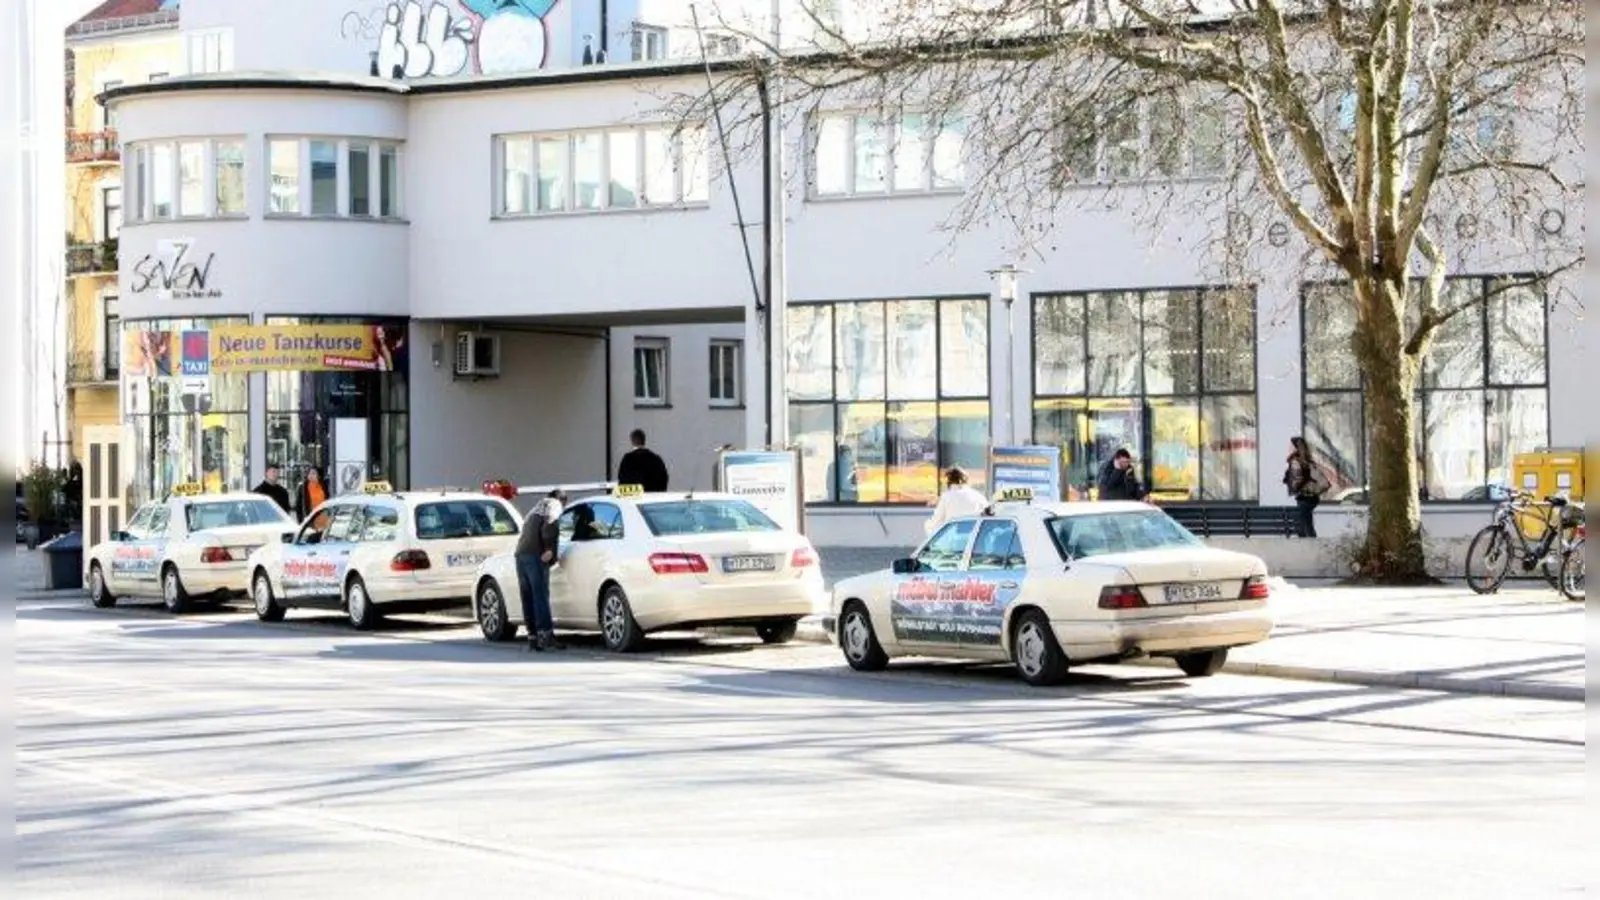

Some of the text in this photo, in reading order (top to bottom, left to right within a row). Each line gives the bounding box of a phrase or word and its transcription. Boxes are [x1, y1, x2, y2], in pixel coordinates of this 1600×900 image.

[219, 332, 362, 351] Neue Tanzkurse
[183, 360, 208, 374] TAXI
